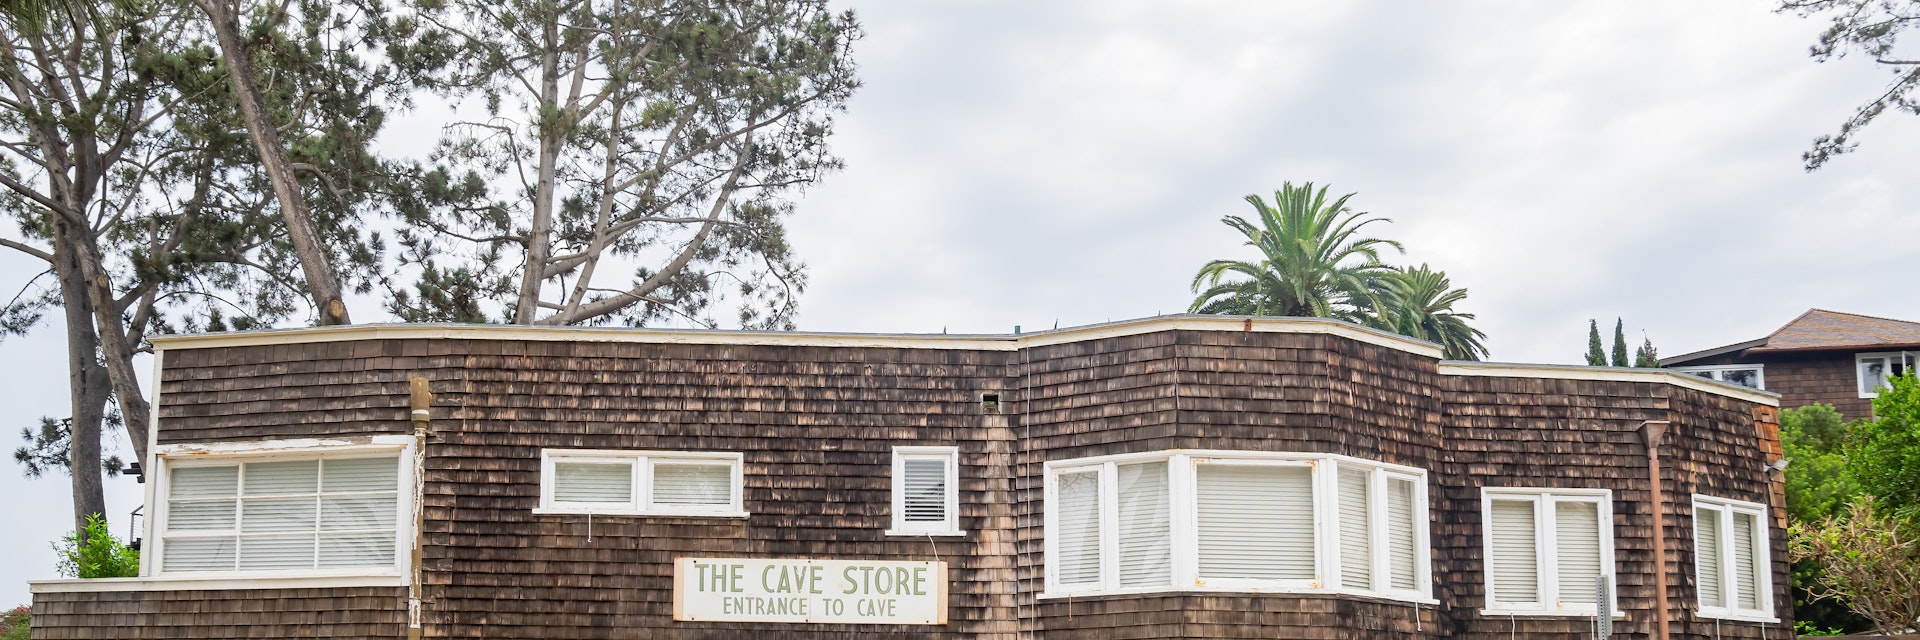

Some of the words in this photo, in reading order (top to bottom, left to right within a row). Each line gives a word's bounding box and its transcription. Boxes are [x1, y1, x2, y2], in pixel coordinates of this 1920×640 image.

[694, 564, 744, 593] THE
[761, 565, 823, 594] CAVE
[843, 566, 927, 596] STORE
[723, 597, 807, 616] ENTRANCE
[823, 598, 844, 616] TO
[857, 598, 896, 617] CAVE
